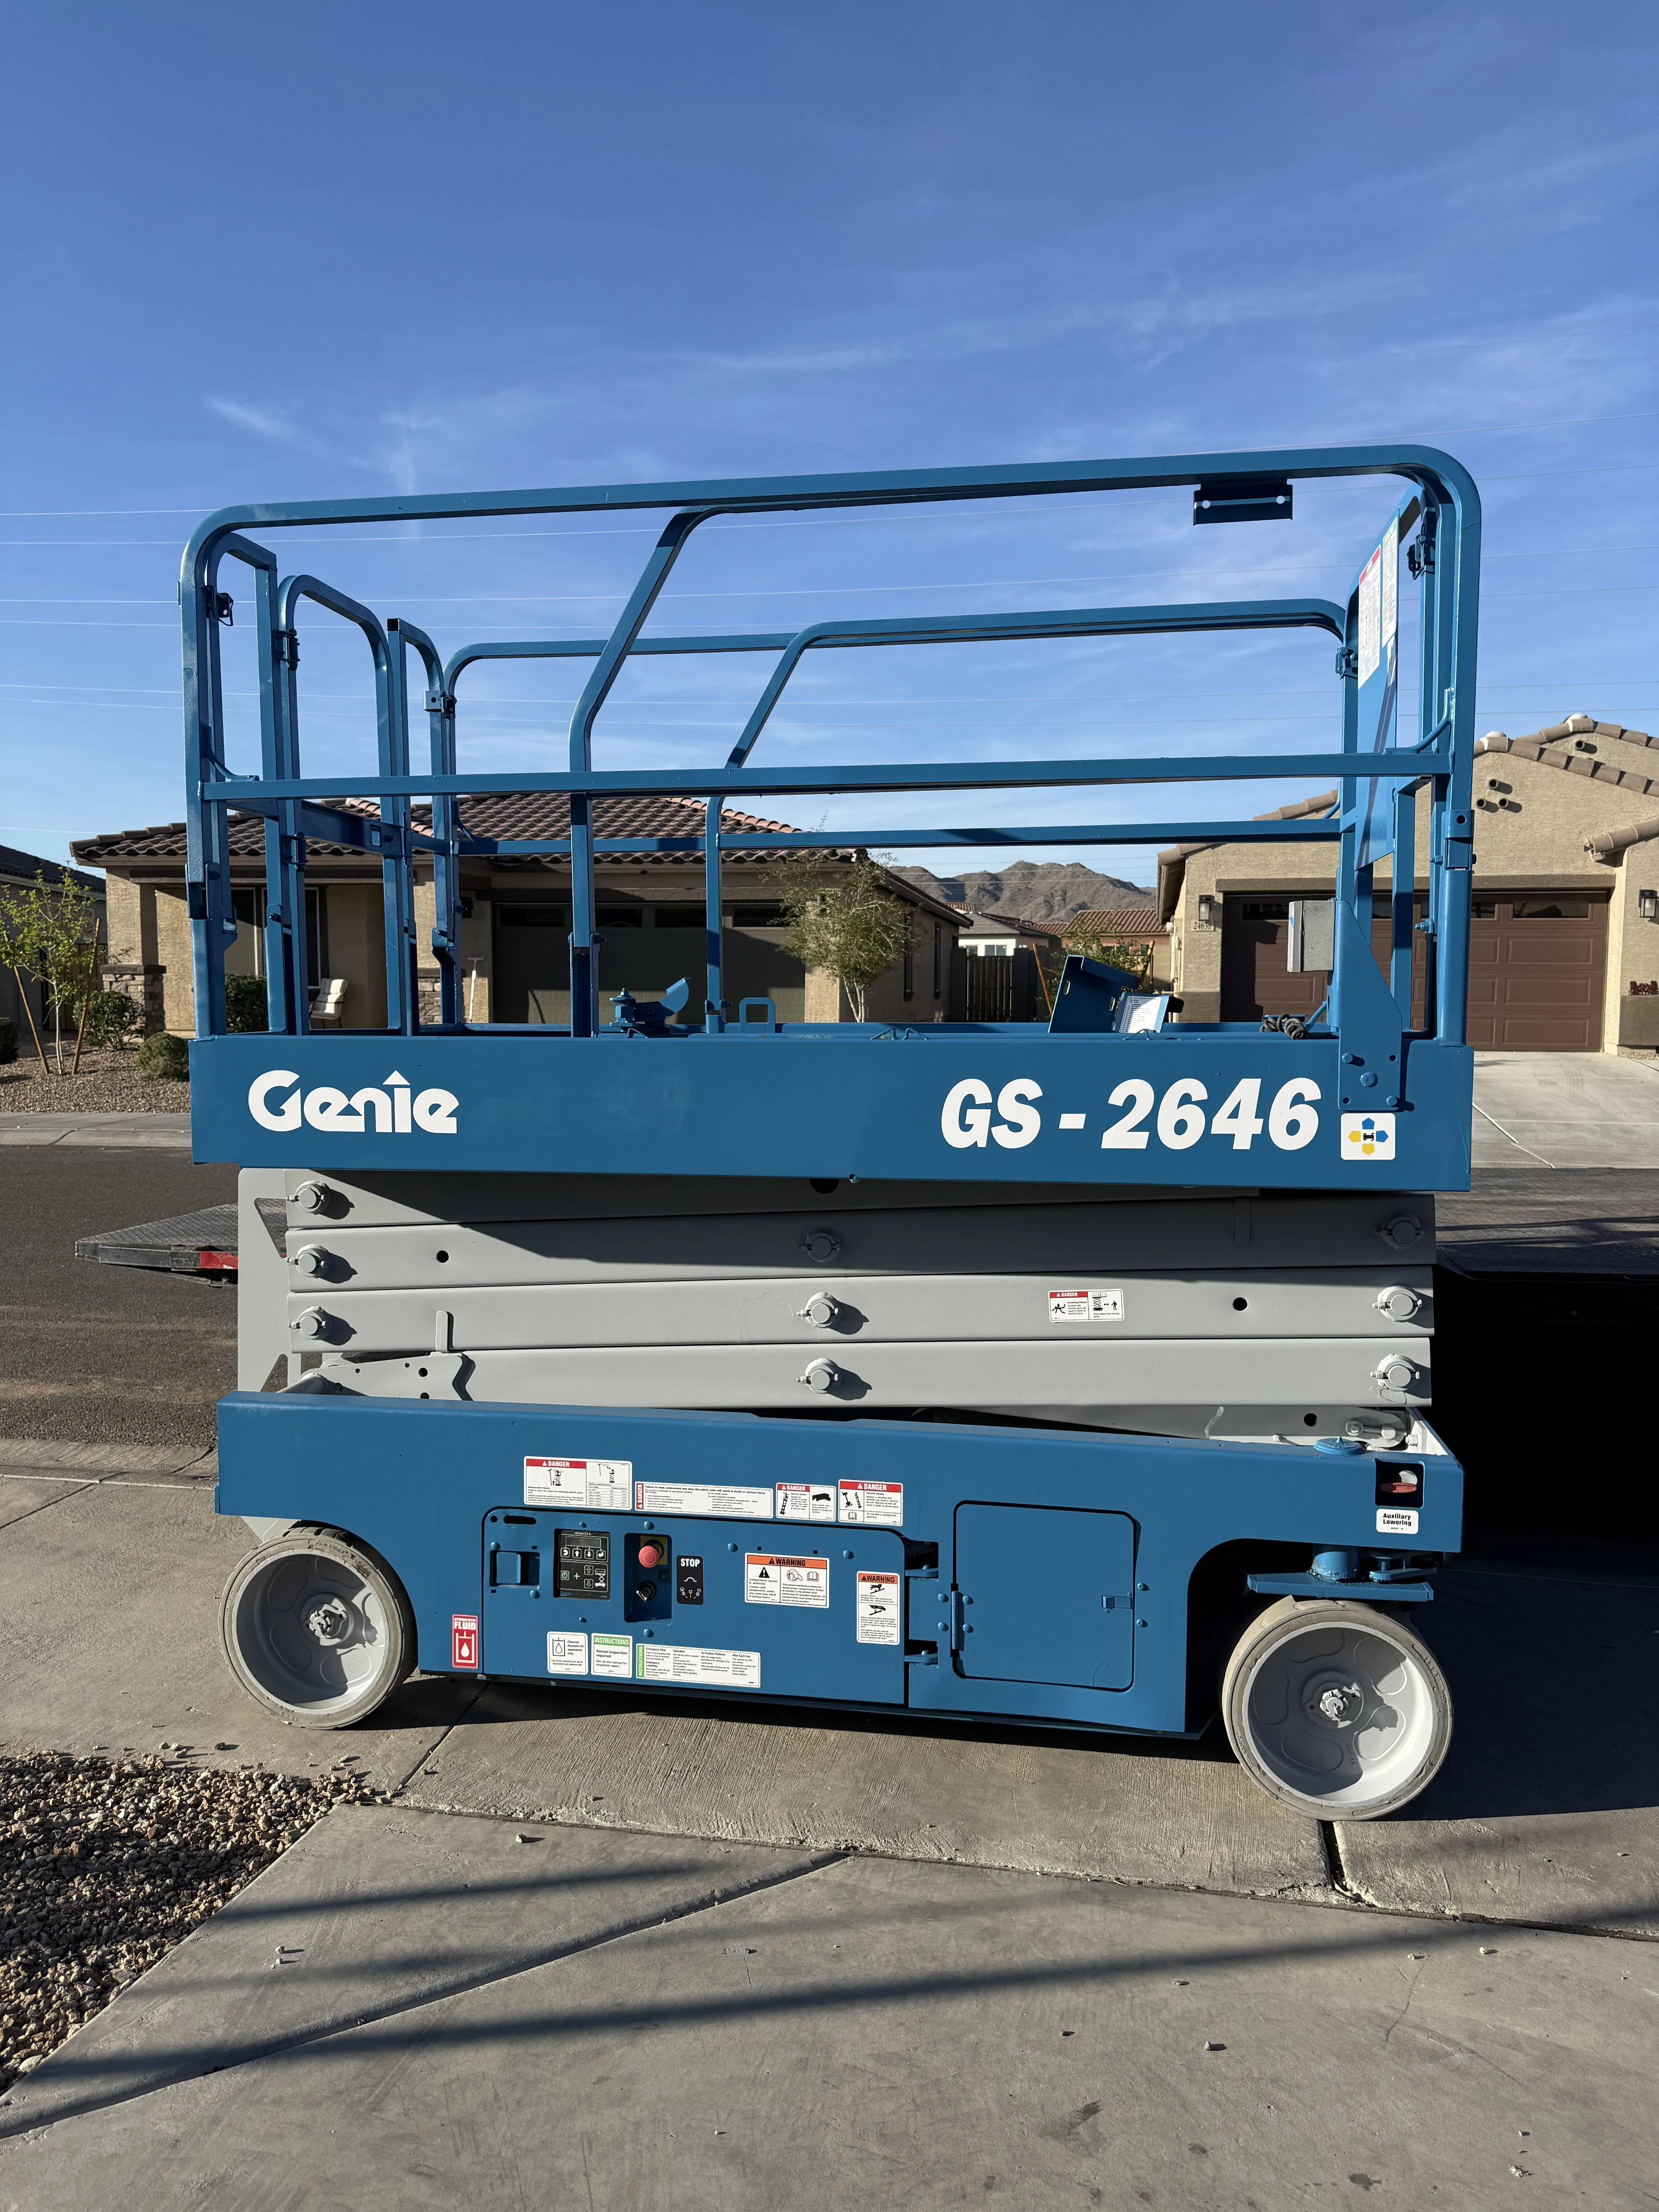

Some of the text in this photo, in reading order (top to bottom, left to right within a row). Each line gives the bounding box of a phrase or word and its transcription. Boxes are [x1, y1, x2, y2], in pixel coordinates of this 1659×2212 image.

[248, 1070, 459, 1133] Genie
[941, 1077, 1321, 1150] GS - 2646
[680, 1558, 700, 1567] STOP
[776, 1558, 805, 1566] WARNING
[454, 1621, 476, 1630] FLUID
[594, 1637, 629, 1645] INSTRUCTIONS
